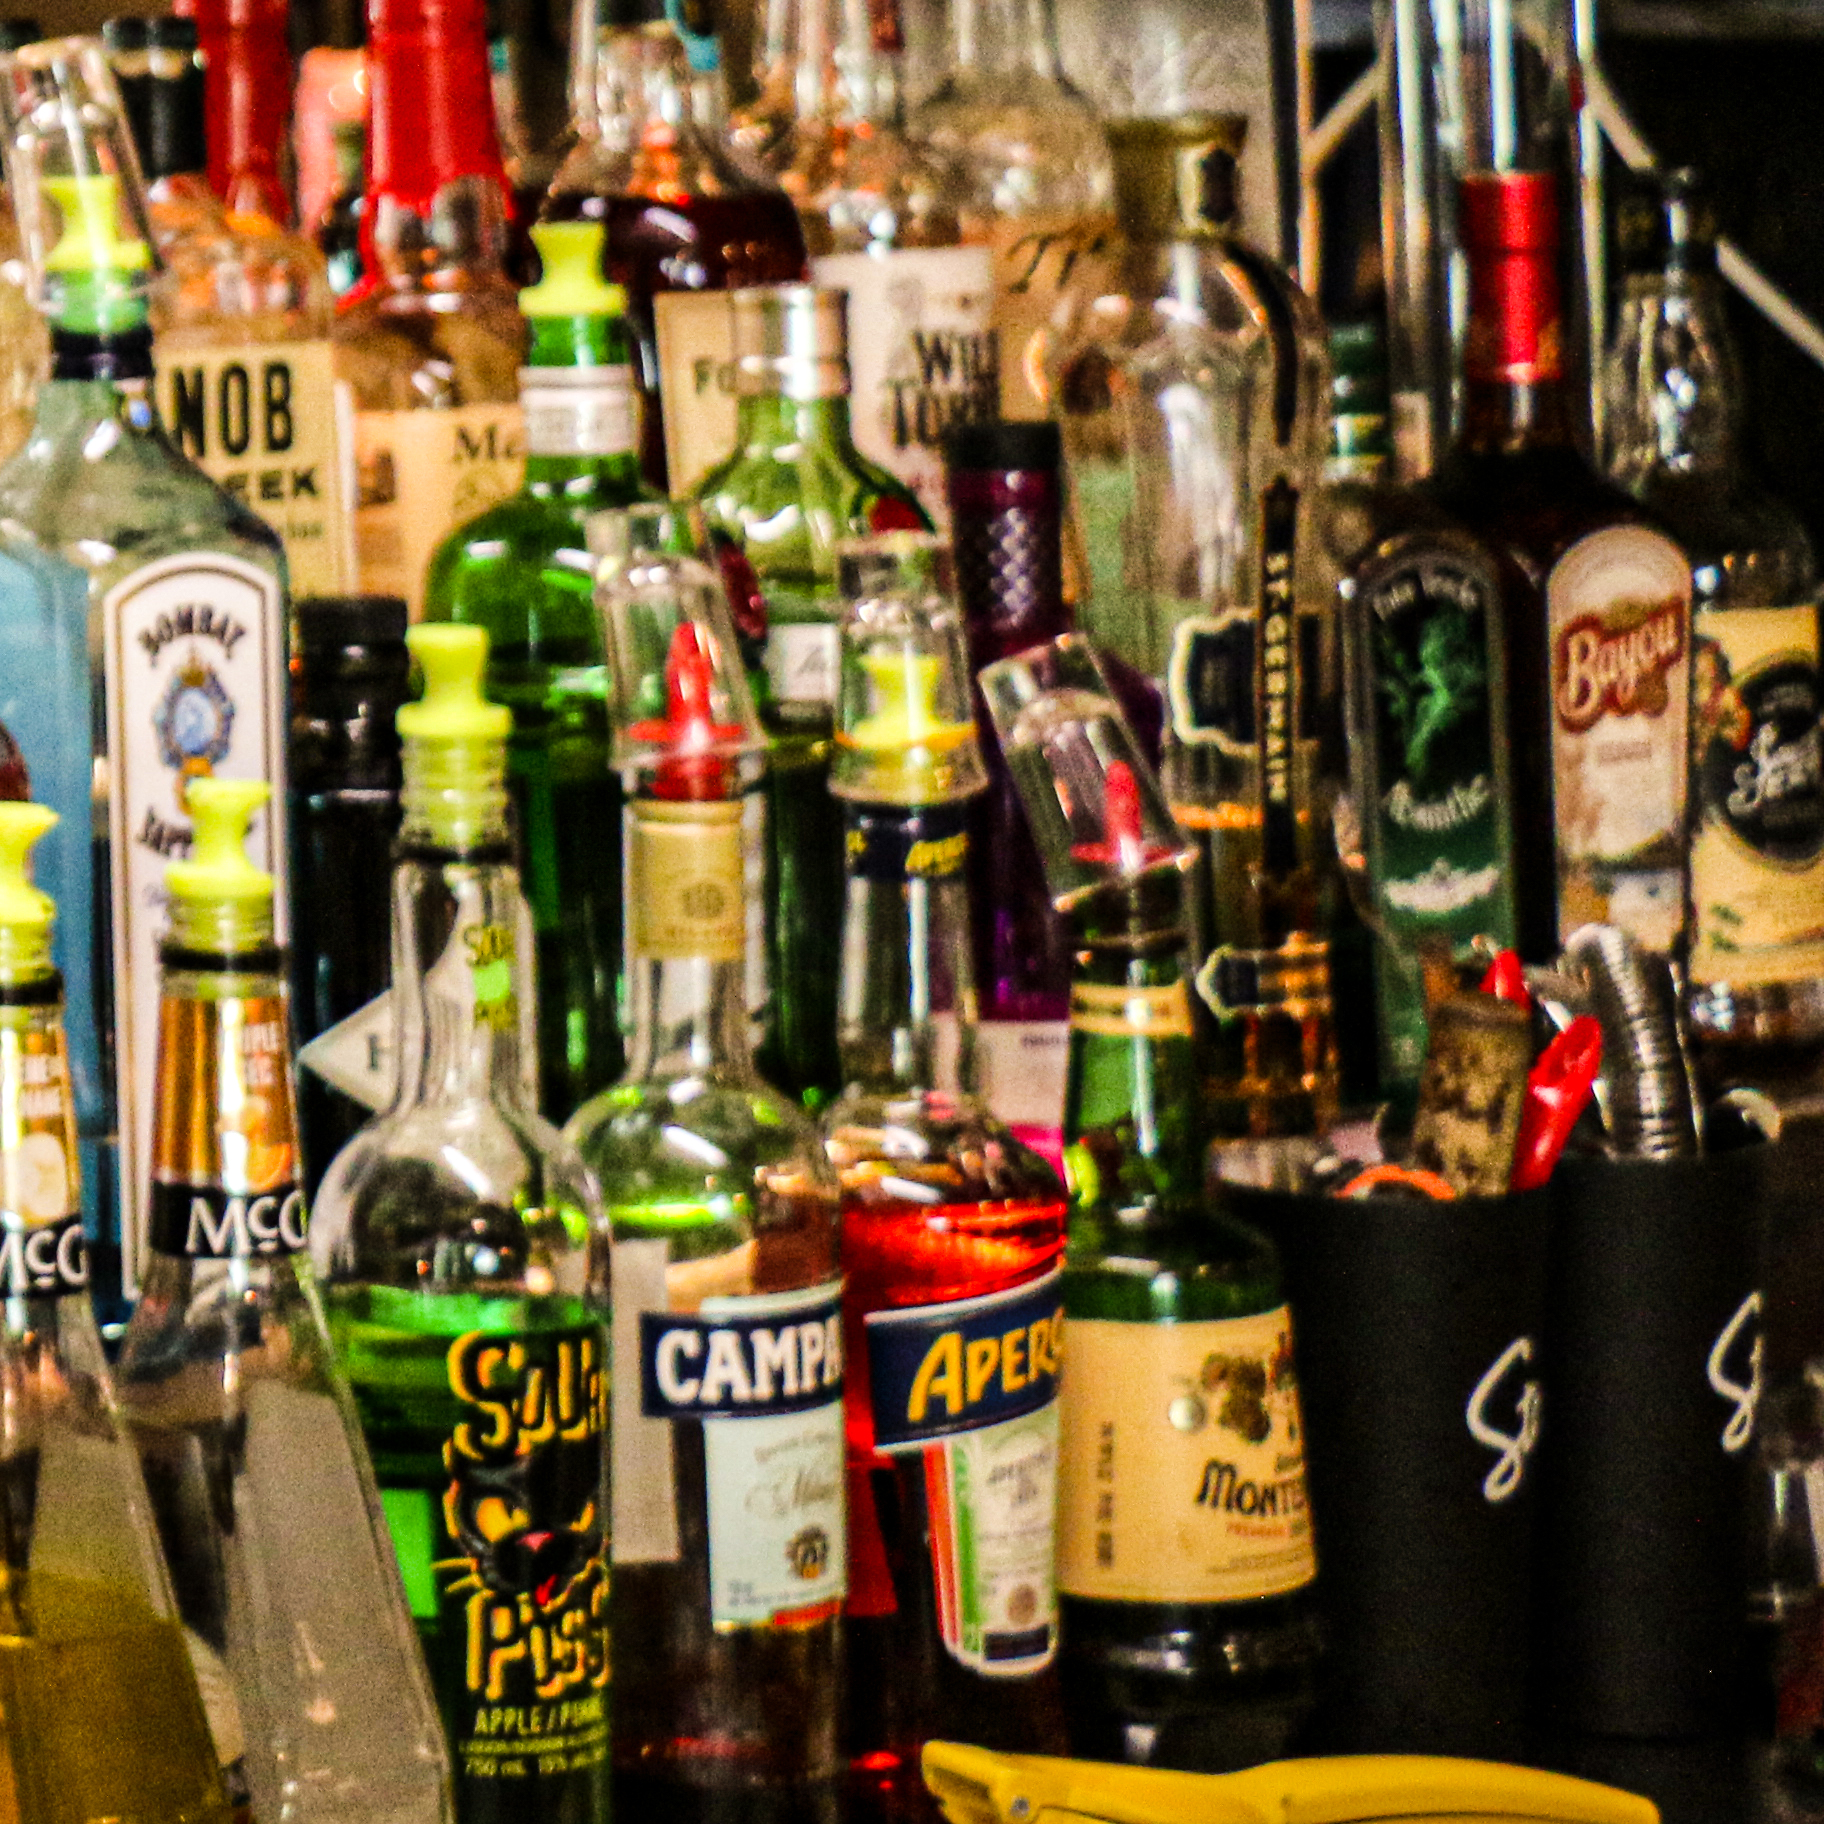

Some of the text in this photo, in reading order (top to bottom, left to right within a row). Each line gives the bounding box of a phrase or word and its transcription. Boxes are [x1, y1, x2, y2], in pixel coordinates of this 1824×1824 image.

[174, 360, 292, 459] NOB
[138, 604, 246, 668] BOMBAY
[655, 1321, 842, 1405] CAMPA
[473, 1706, 541, 1737] APPLE
